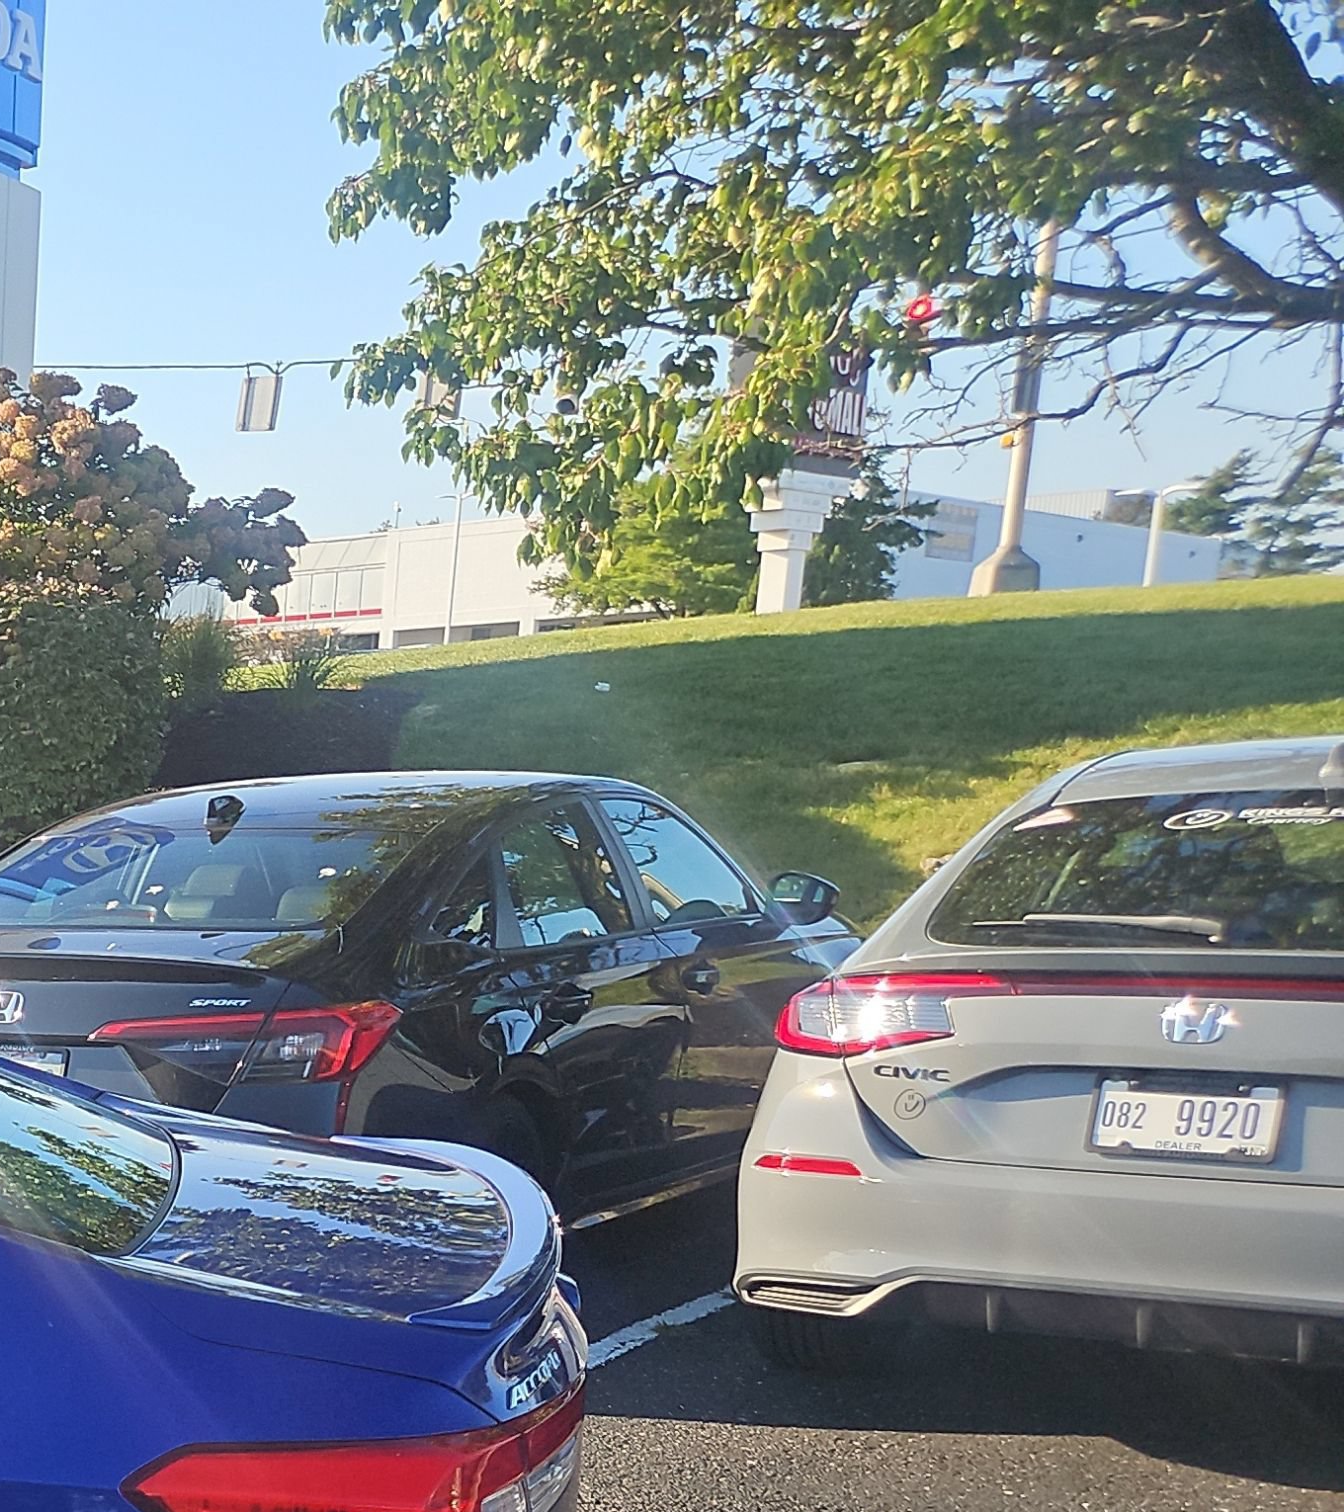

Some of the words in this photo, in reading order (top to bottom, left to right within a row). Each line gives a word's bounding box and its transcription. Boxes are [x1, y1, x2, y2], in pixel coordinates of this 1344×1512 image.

[188, 998, 252, 1008] SPORT
[873, 1064, 951, 1083] CIVIC
[1101, 1100, 1147, 1130] 082
[1174, 1099, 1261, 1140] 9920
[1154, 1139, 1203, 1152] DEALER
